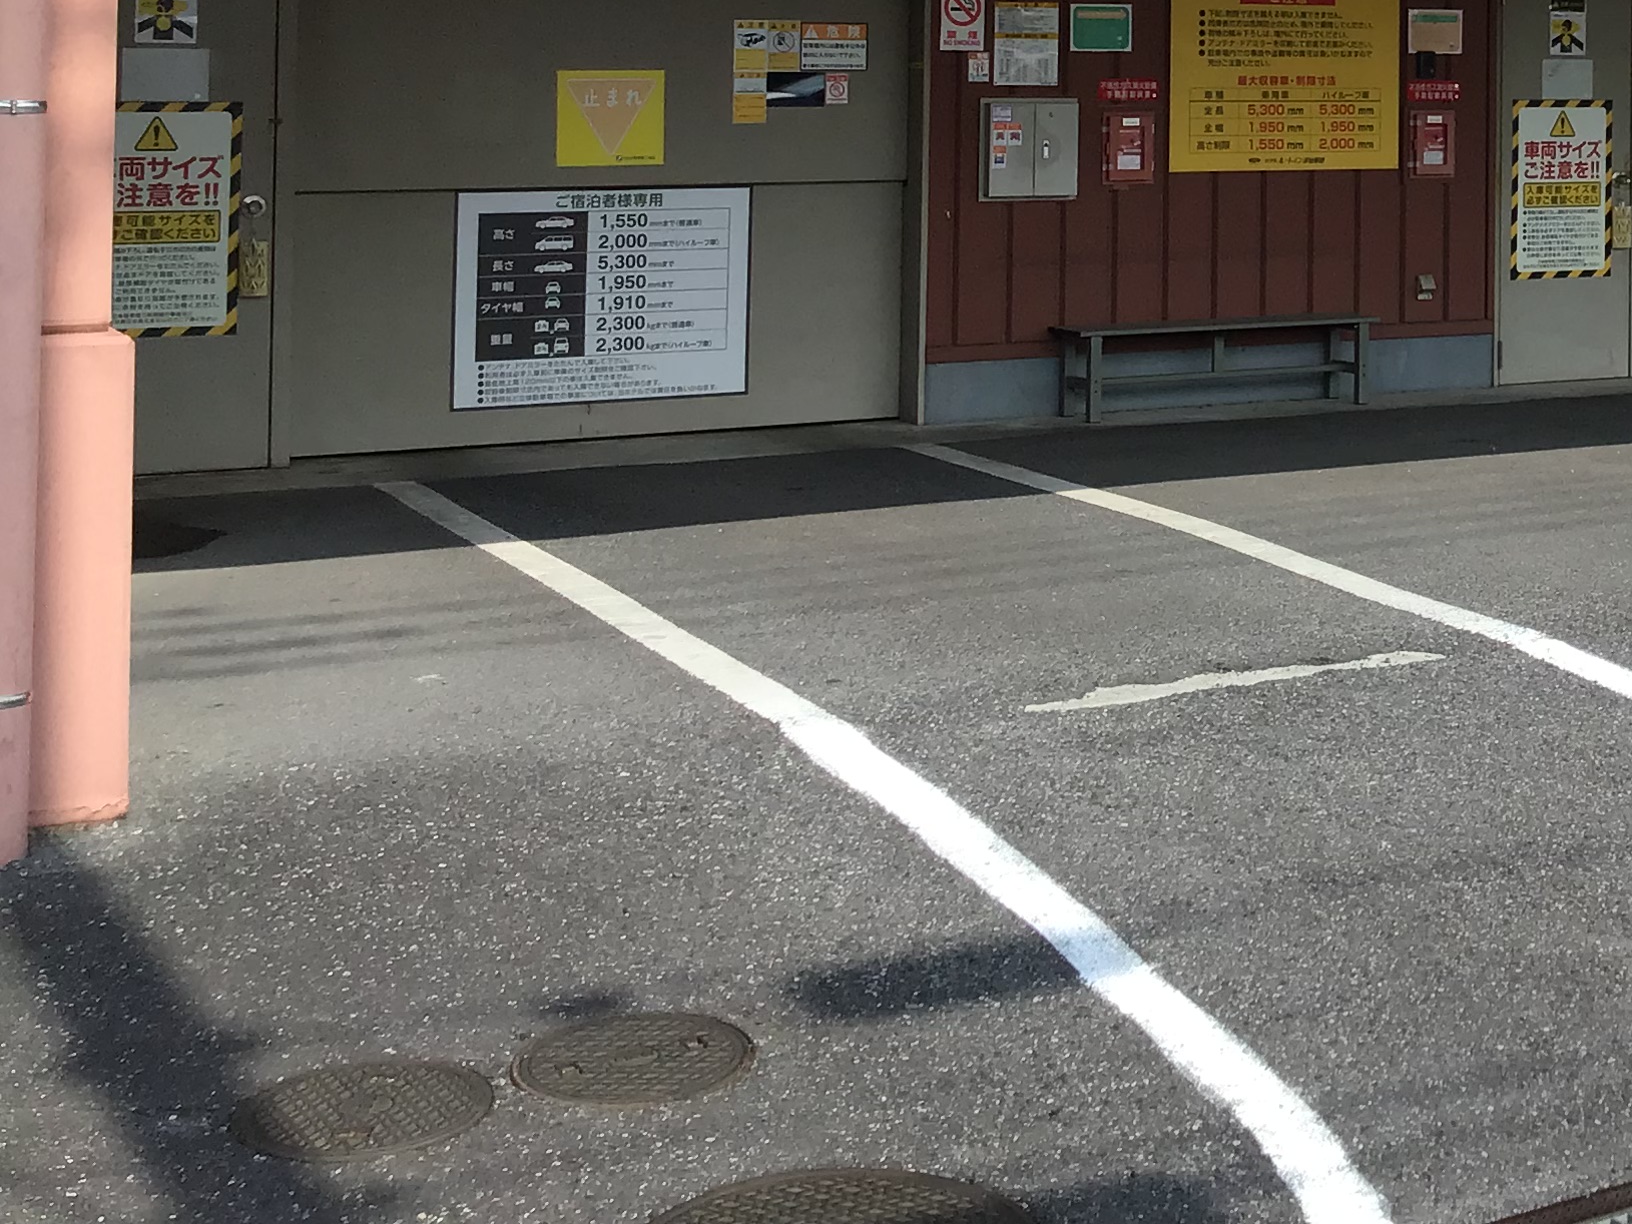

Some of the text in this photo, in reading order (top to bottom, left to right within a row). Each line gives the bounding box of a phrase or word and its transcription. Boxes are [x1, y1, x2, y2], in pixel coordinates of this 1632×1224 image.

[583, 87, 643, 107] 止まれ
[1247, 103, 1285, 117] 5,300
[1287, 106, 1304, 116] mm
[1319, 103, 1356, 117] 5,300
[1248, 121, 1284, 134] 1,950
[1287, 124, 1304, 133] mm
[1320, 121, 1355, 134] 1,950
[1248, 138, 1284, 151] 1,550
[1287, 140, 1304, 150] mm
[1318, 138, 1356, 151] 2,000
[1524, 139, 1602, 160] 車両サイズ
[114, 154, 224, 181] 両サイズ
[556, 193, 664, 209] ご宿泊者様専用
[600, 213, 648, 232] 1,550
[599, 233, 648, 253] 2,000
[598, 254, 647, 274] 5,300
[598, 275, 647, 293] 1,950
[598, 295, 646, 314] 1,910
[596, 316, 646, 335] 2,300
[595, 336, 645, 355] 2,300
